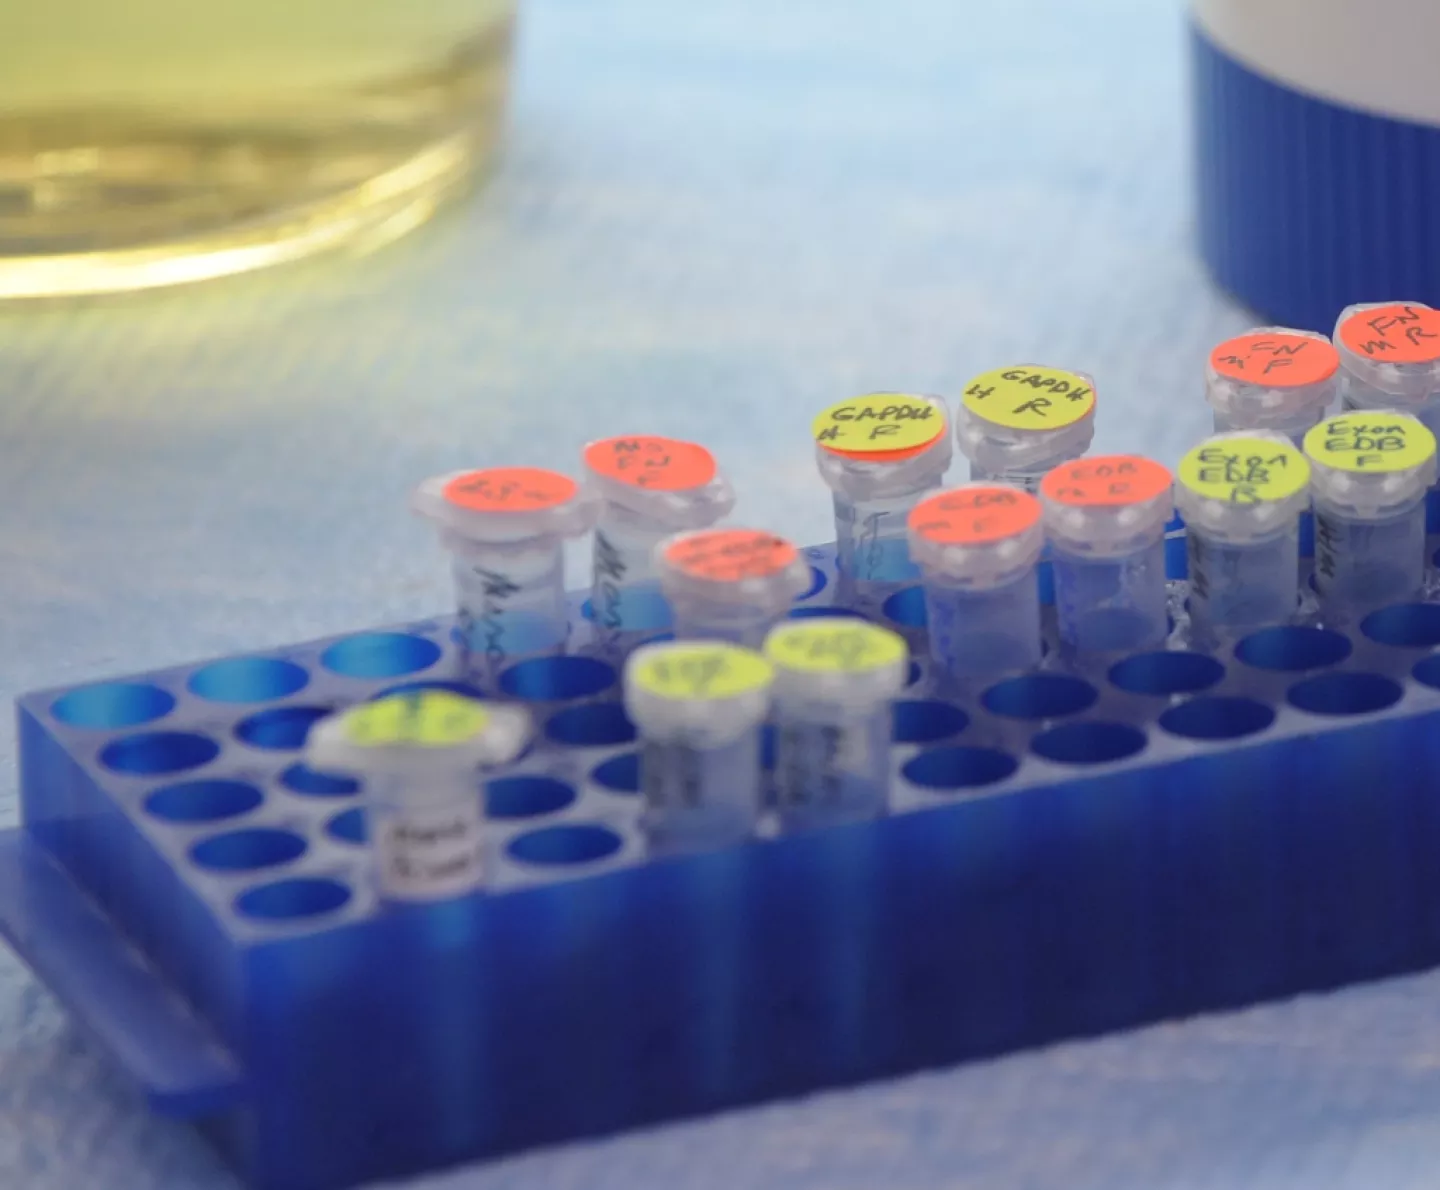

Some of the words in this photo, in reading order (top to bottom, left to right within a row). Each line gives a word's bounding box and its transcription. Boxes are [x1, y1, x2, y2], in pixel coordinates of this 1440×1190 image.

[1000, 369, 1092, 402] GAPDH
[831, 404, 934, 421] GAPDH
[1011, 397, 1053, 417] R
[1324, 435, 1406, 452] EDB
[1355, 454, 1384, 468] F
